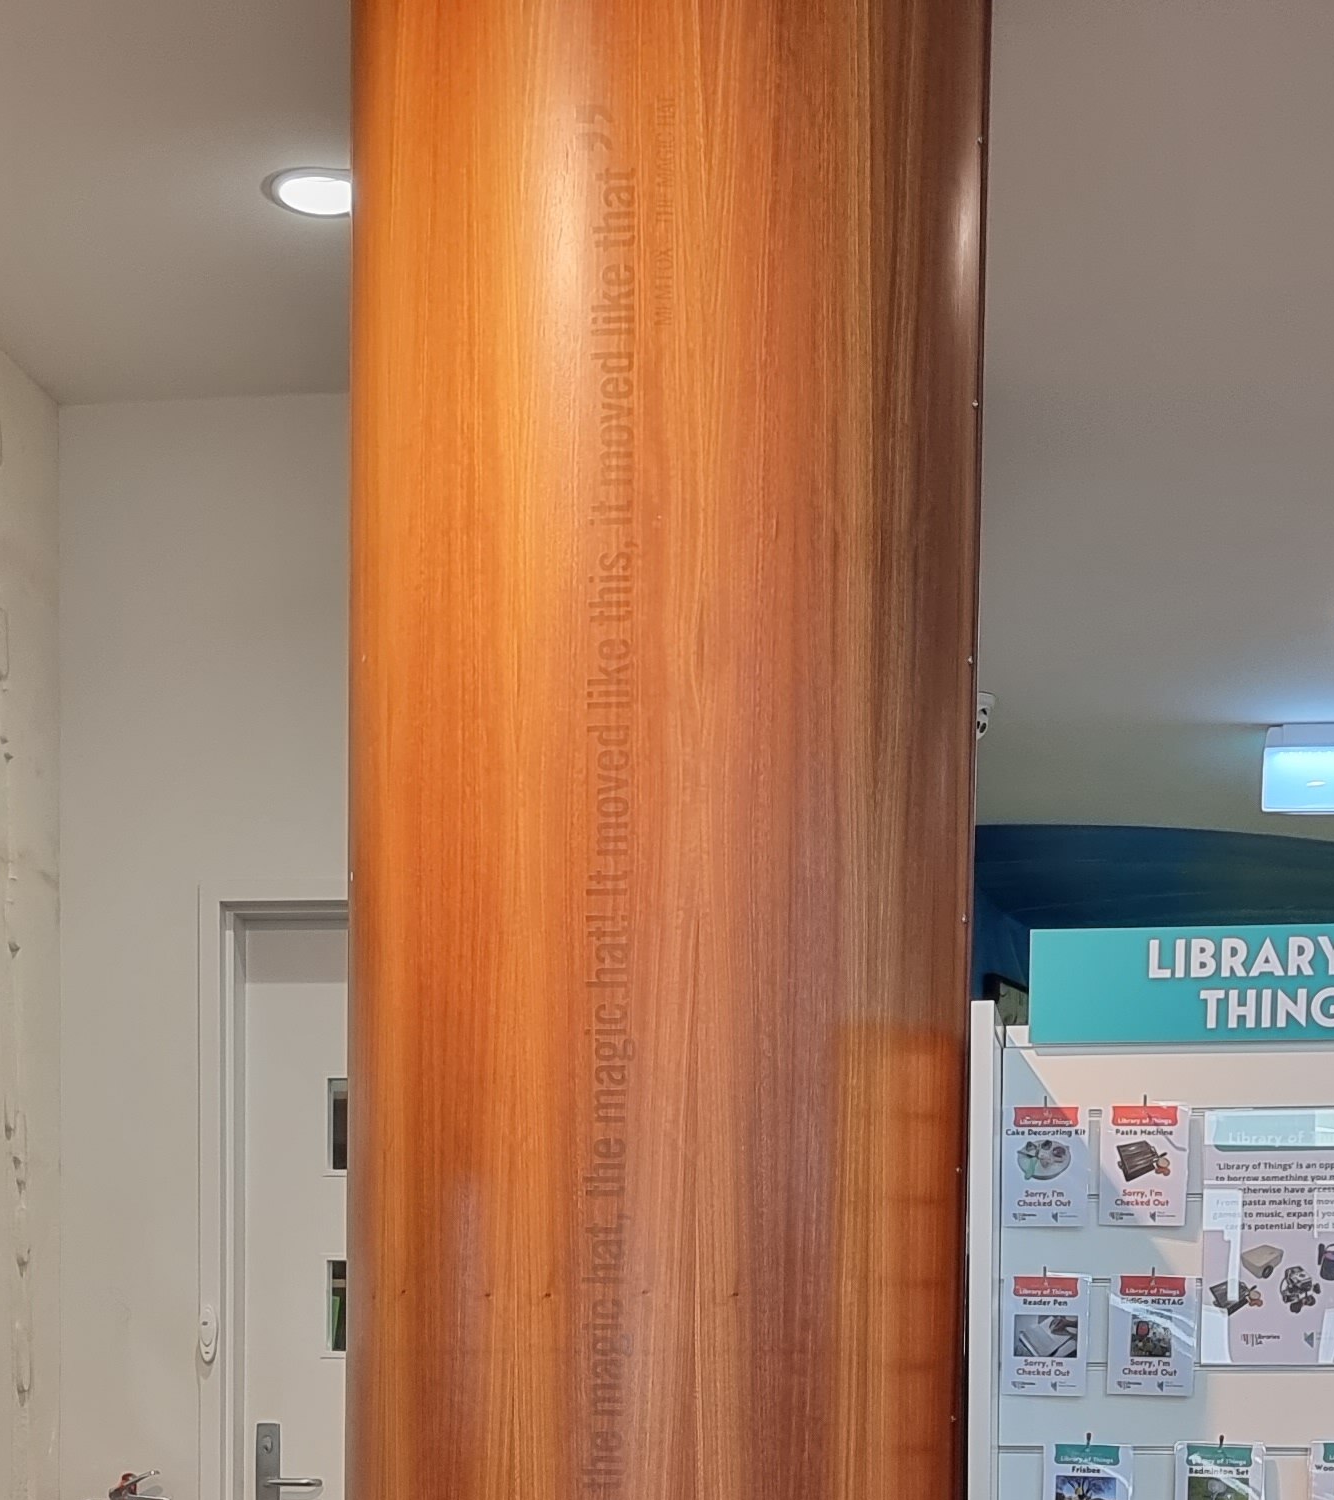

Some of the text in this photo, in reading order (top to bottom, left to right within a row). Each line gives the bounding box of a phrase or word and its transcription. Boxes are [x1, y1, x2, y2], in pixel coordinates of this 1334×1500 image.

[655, 95, 677, 127] HAT
[655, 132, 676, 189] MAGIC
[591, 263, 635, 340] like
[590, 350, 634, 485] moved
[589, 500, 633, 528] it
[588, 540, 638, 626] this,
[586, 636, 633, 710] like
[586, 724, 630, 857] moved
[585, 868, 629, 898] It
[585, 912, 629, 989] hat!
[584, 1002, 635, 1123] magic
[1028, 1129, 1072, 1137] Decorating
[1228, 1132, 1284, 1145] Library
[1288, 1132, 1306, 1143] of
[585, 1136, 627, 1197] the
[1252, 1162, 1261, 1170] of
[1261, 1174, 1309, 1182] something
[1024, 1190, 1064, 1199] Sorry, I'm
[1115, 1199, 1169, 1207] Checked Out
[1122, 1189, 1148, 1199] Sorry,
[1243, 1198, 1266, 1207] pasta
[1269, 1198, 1302, 1207] making
[1304, 1198, 1314, 1206] to
[1284, 1186, 1305, 1194] have
[1255, 1222, 1294, 1232] potential
[1256, 1210, 1284, 1219] music,
[582, 1211, 632, 1286] hat,
[581, 1297, 635, 1417] magic
[1024, 1359, 1063, 1368] Sorry, I'm
[581, 1430, 624, 1490] the
[1071, 1465, 1101, 1475] Frisbee
[1236, 1468, 1249, 1476] Set
